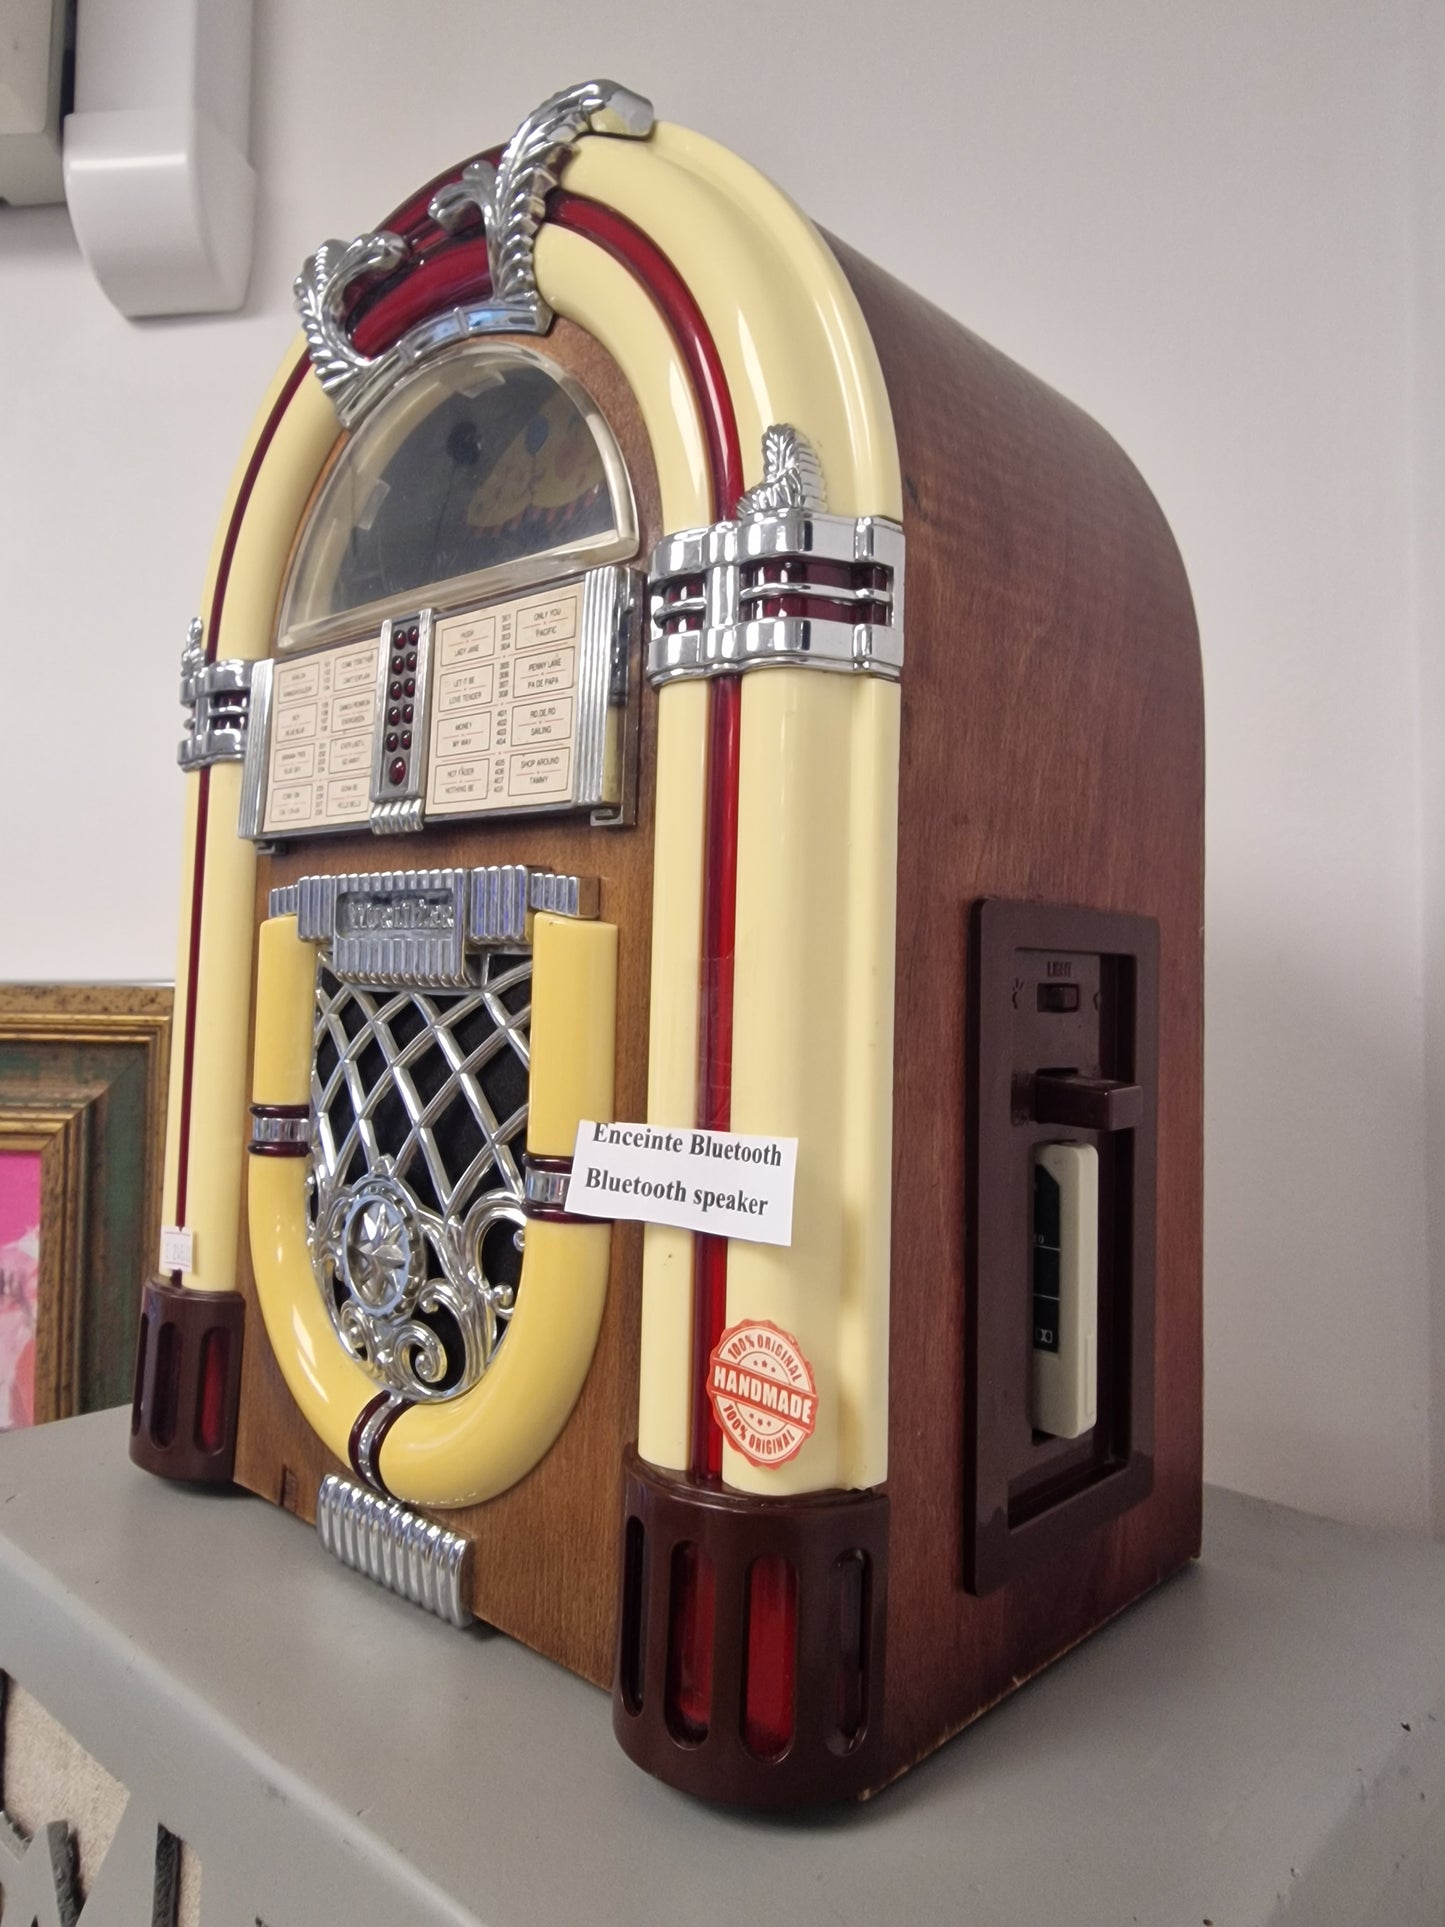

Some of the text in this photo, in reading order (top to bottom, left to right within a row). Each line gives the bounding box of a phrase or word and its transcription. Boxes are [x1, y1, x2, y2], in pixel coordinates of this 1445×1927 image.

[592, 1122, 782, 1167] Enceinte Bluetooth
[585, 1167, 769, 1216] Bluetooth speaker
[727, 1333, 802, 1382] 100% ORIGINAL
[713, 1365, 813, 1425] HANDMADE
[723, 1404, 796, 1455] 100% ORIGINAL
